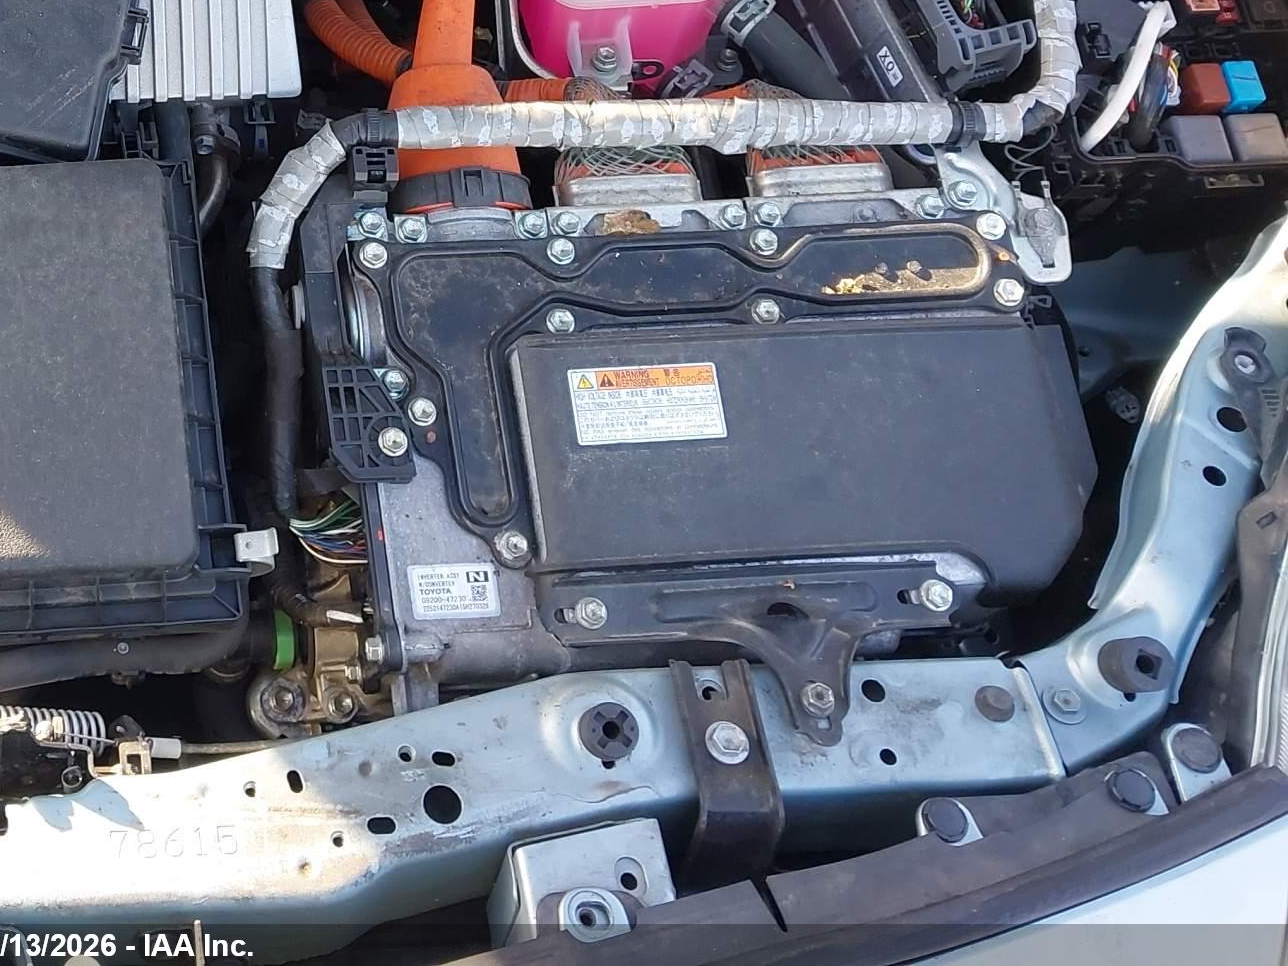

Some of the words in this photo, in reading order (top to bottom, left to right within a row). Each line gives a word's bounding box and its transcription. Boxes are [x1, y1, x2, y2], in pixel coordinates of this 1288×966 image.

[613, 369, 650, 379] WARNING
[615, 378, 660, 388] AVERTISSEMENT
[108, 825, 238, 859] 78615
